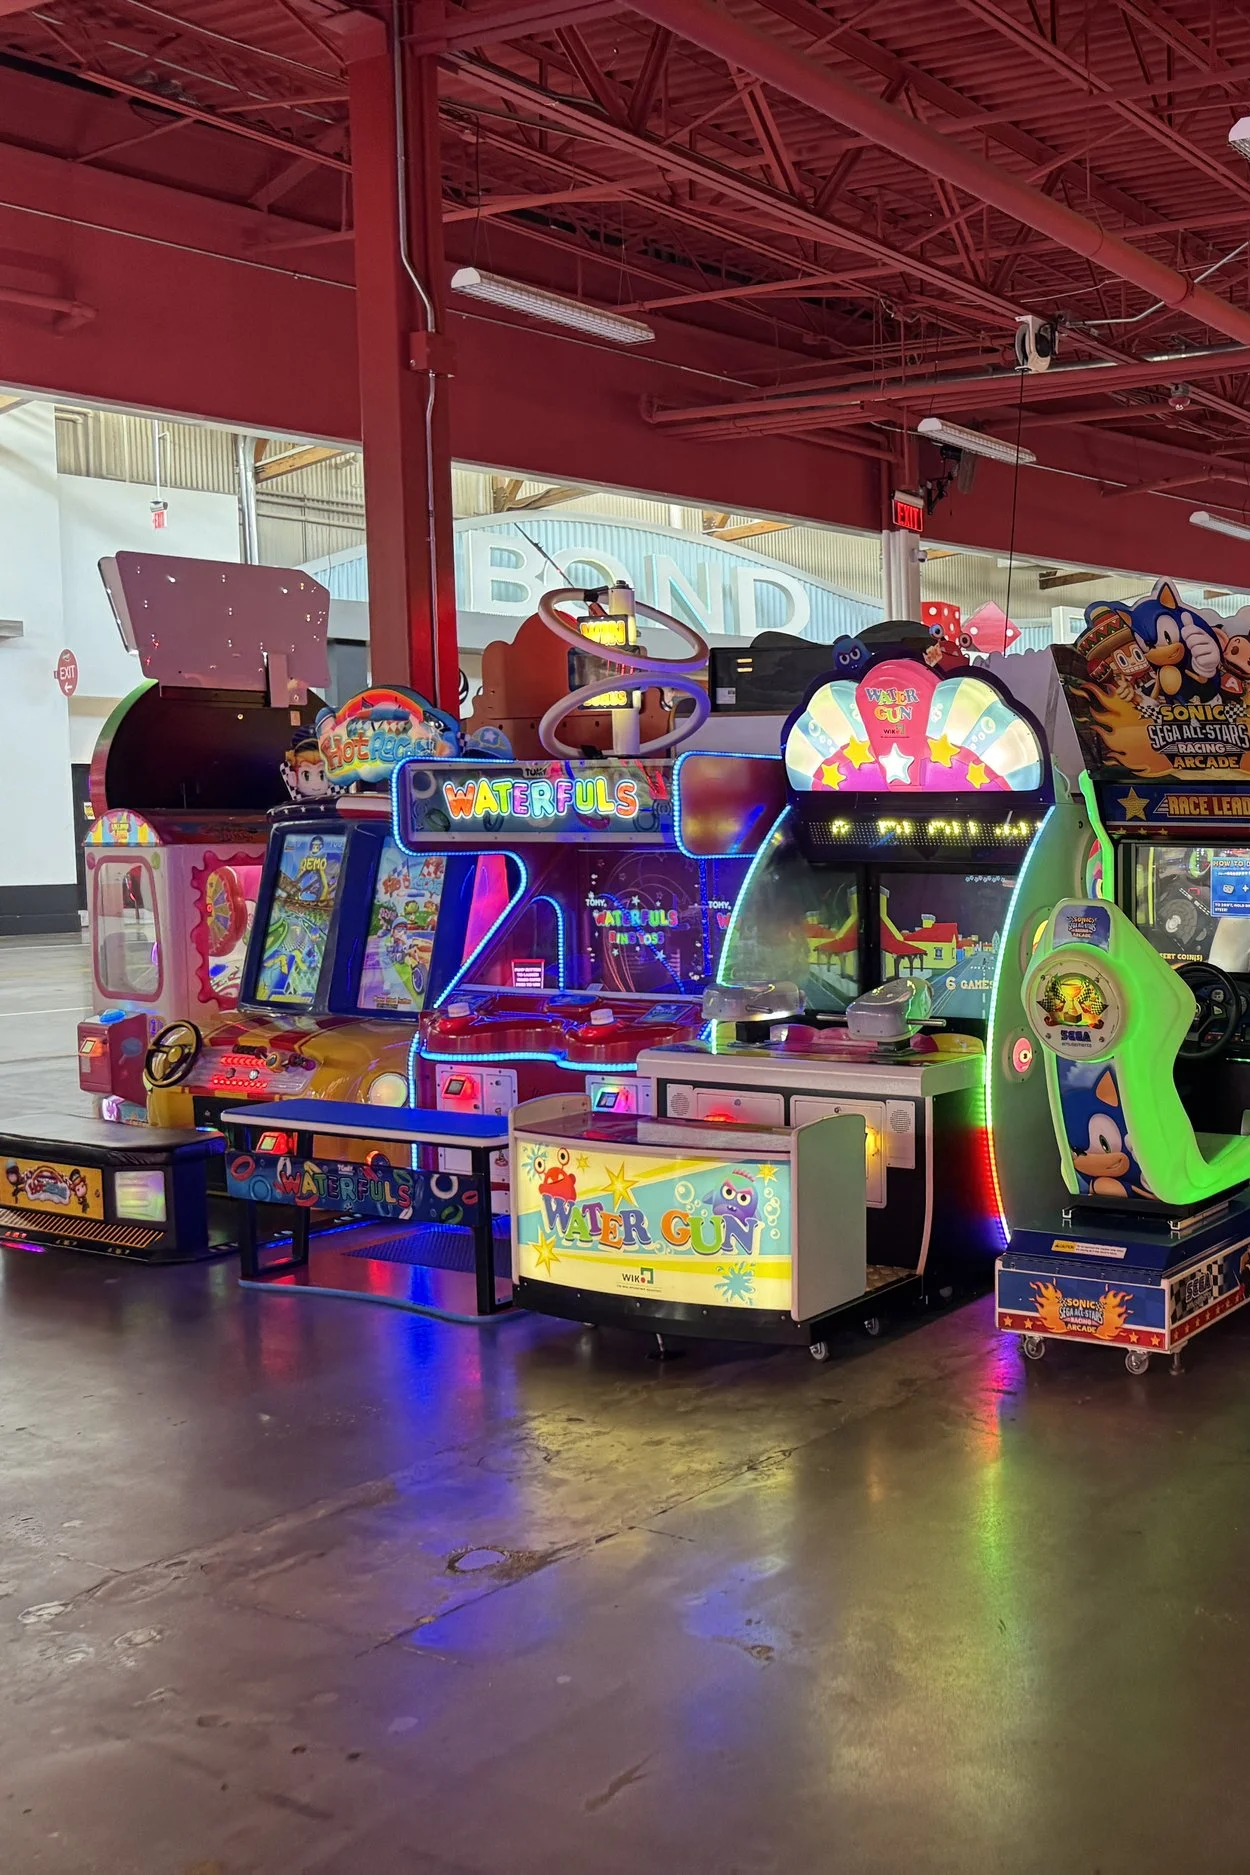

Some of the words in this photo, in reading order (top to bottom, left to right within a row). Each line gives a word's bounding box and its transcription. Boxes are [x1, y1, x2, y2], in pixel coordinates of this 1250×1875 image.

[897, 502, 920, 530] EXIT
[469, 529, 811, 638] BOND
[60, 664, 76, 681] EXIT
[865, 687, 920, 705] WATER
[874, 705, 913, 723] GUN
[1160, 703, 1227, 723] SONIC
[1149, 723, 1181, 748] SEGA
[1177, 742, 1226, 755] RACING
[1172, 755, 1240, 769] ARCADE
[443, 774, 639, 819] WATERFULS
[1169, 796, 1209, 816] RACE
[301, 857, 328, 872] DEMO
[595, 909, 679, 928] WATERFULS
[608, 930, 636, 945] RING
[637, 931, 665, 946] TOSS
[945, 976, 957, 991] 6
[1060, 1029, 1092, 1042] SEGA
[280, 1170, 413, 1209] WATERFULS
[541, 1193, 651, 1251] WATER
[661, 1210, 764, 1256] GUN
[622, 1273, 641, 1283] WIK
[1185, 1270, 1214, 1304] SEGA
[1066, 1298, 1097, 1309] SONIC
[1059, 1306, 1074, 1320] SEGA
[1073, 1306, 1104, 1324] ALL-STARS
[1070, 1317, 1092, 1326] RACING
[1066, 1323, 1098, 1333] ARCADE
